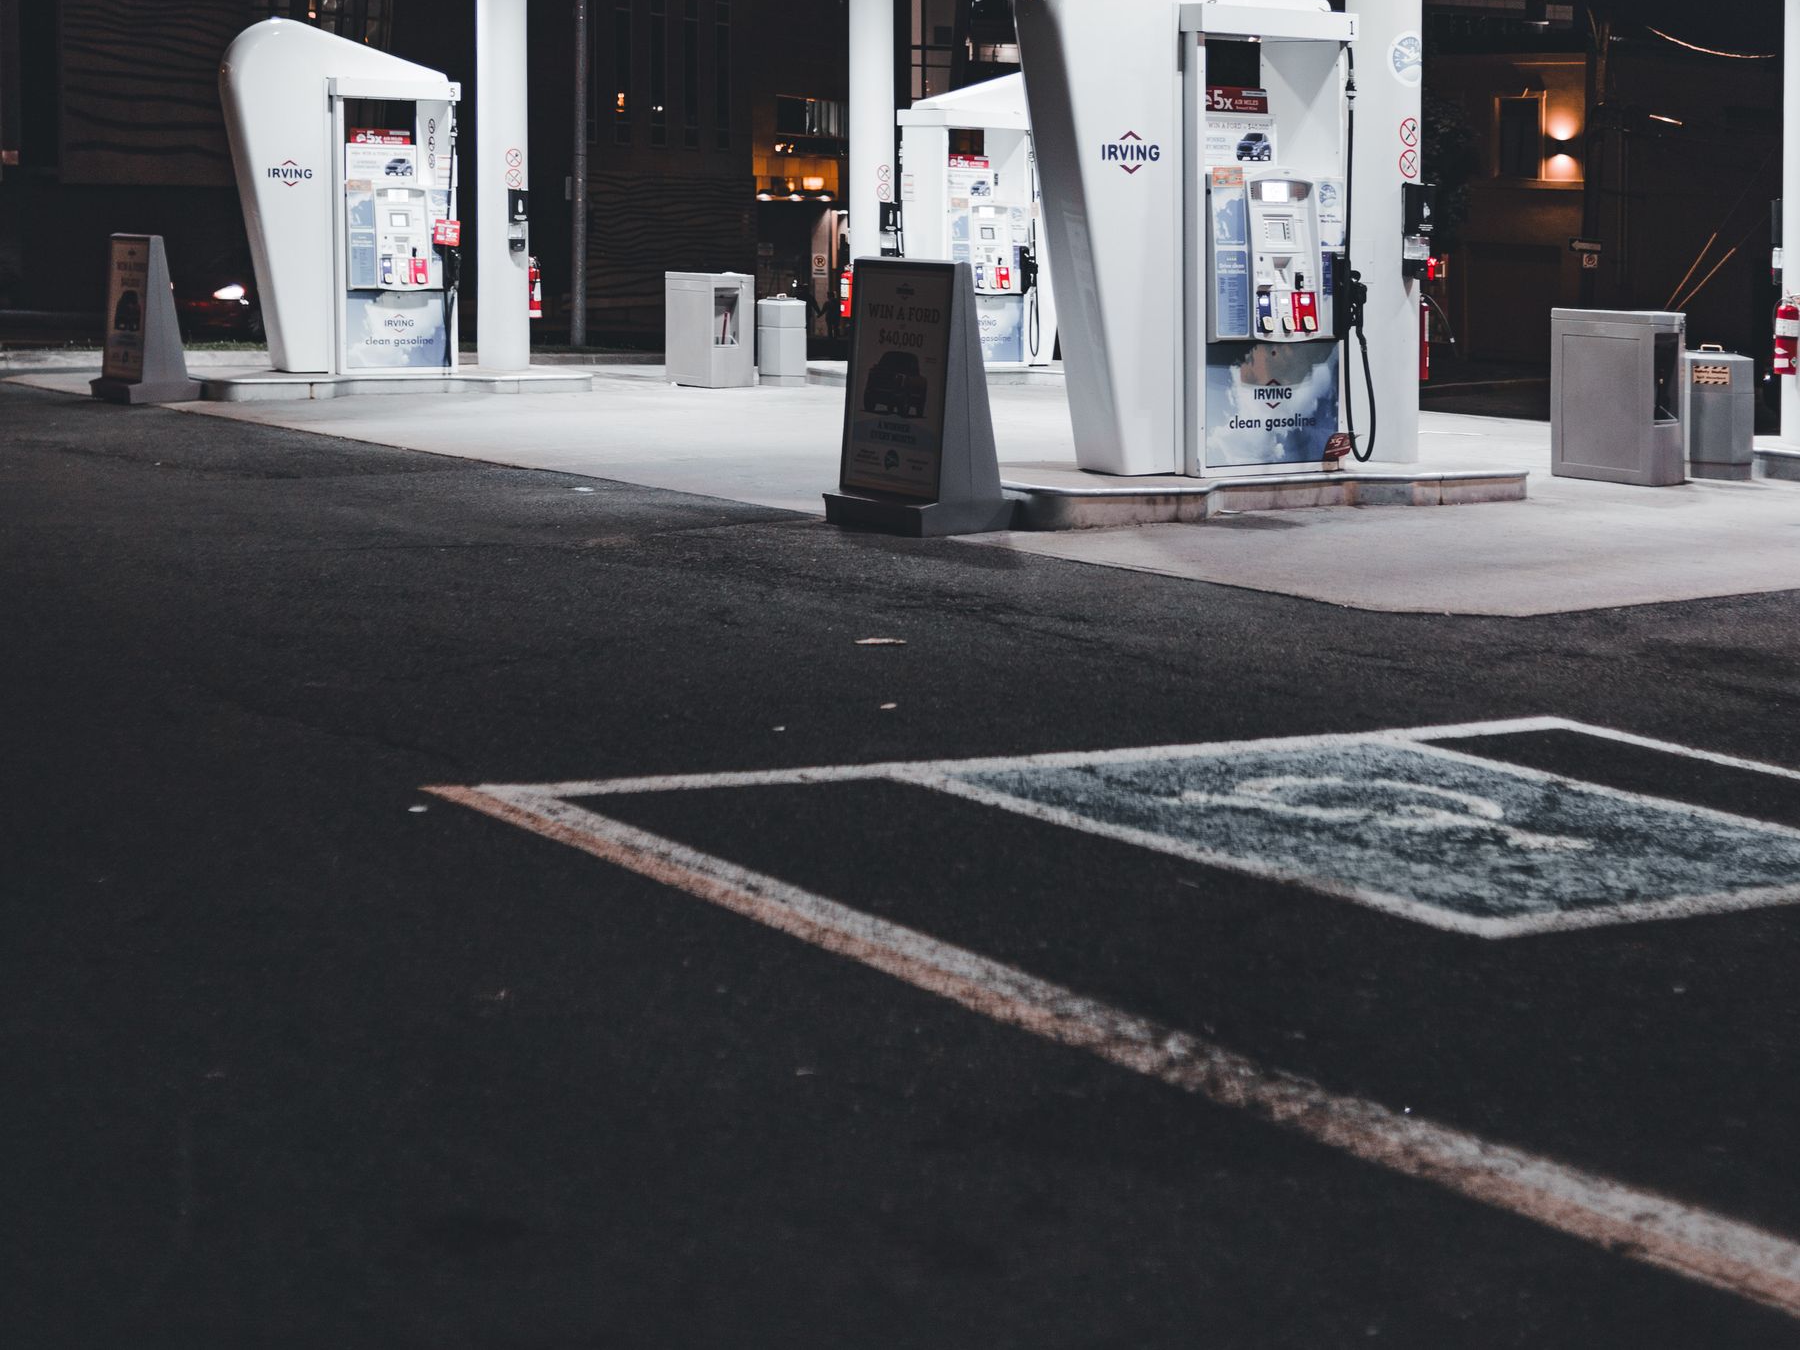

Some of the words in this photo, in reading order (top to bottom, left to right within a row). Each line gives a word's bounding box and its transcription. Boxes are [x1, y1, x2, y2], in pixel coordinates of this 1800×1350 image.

[449, 87, 456, 98] 5
[1213, 89, 1233, 110] 5x
[366, 130, 384, 144] 5x
[1102, 144, 1160, 161] IRVING
[267, 167, 313, 179] IRVING
[868, 303, 894, 320] WIN
[896, 305, 906, 320] A
[908, 306, 941, 324] FORD
[384, 319, 414, 327] IRVING
[366, 335, 390, 345] clean
[394, 334, 434, 347] gasoline
[878, 328, 924, 348] $40,000
[1254, 387, 1293, 400] IRVING
[1229, 415, 1261, 430] clean
[1265, 413, 1318, 431] gasoline
